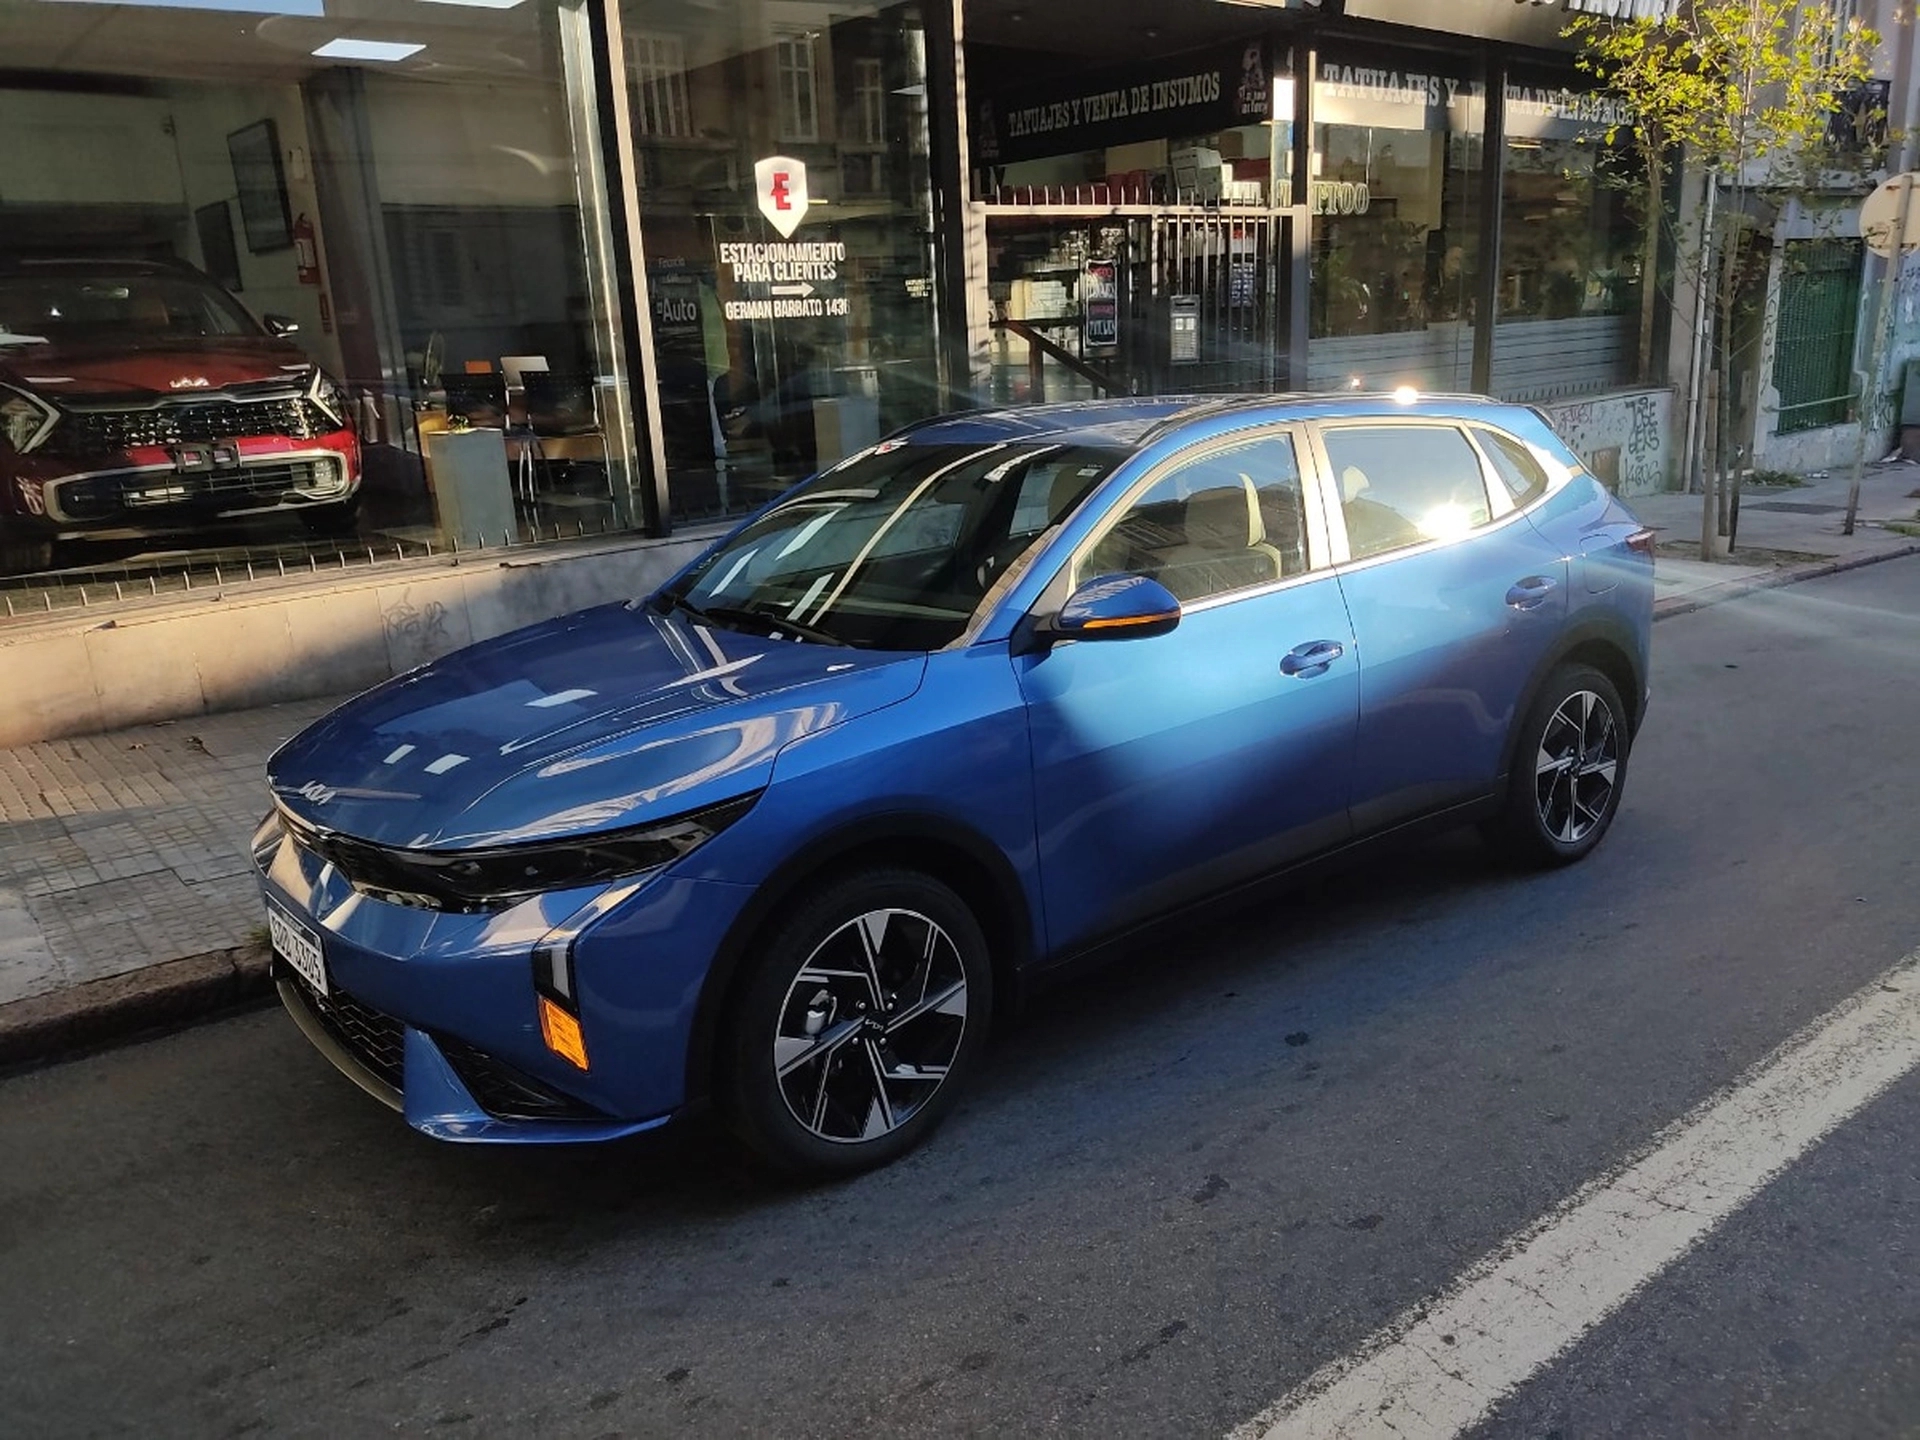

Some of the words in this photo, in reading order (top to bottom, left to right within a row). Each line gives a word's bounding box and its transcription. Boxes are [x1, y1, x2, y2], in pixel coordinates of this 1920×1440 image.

[1323, 64, 1440, 107] TATUAJES
[1444, 78, 1459, 108] Y
[1008, 101, 1070, 137] TATUAJES
[1072, 99, 1081, 125] Y
[1083, 89, 1129, 124] VENTA
[1131, 85, 1149, 115] DE
[1152, 71, 1220, 111] INSUMOS
[719, 242, 846, 264] ESTACIONAMIENTO
[734, 262, 772, 283] PARA
[774, 261, 838, 282] CLIENTES
[725, 301, 773, 321] GERMAN
[774, 299, 823, 318] BARBATO
